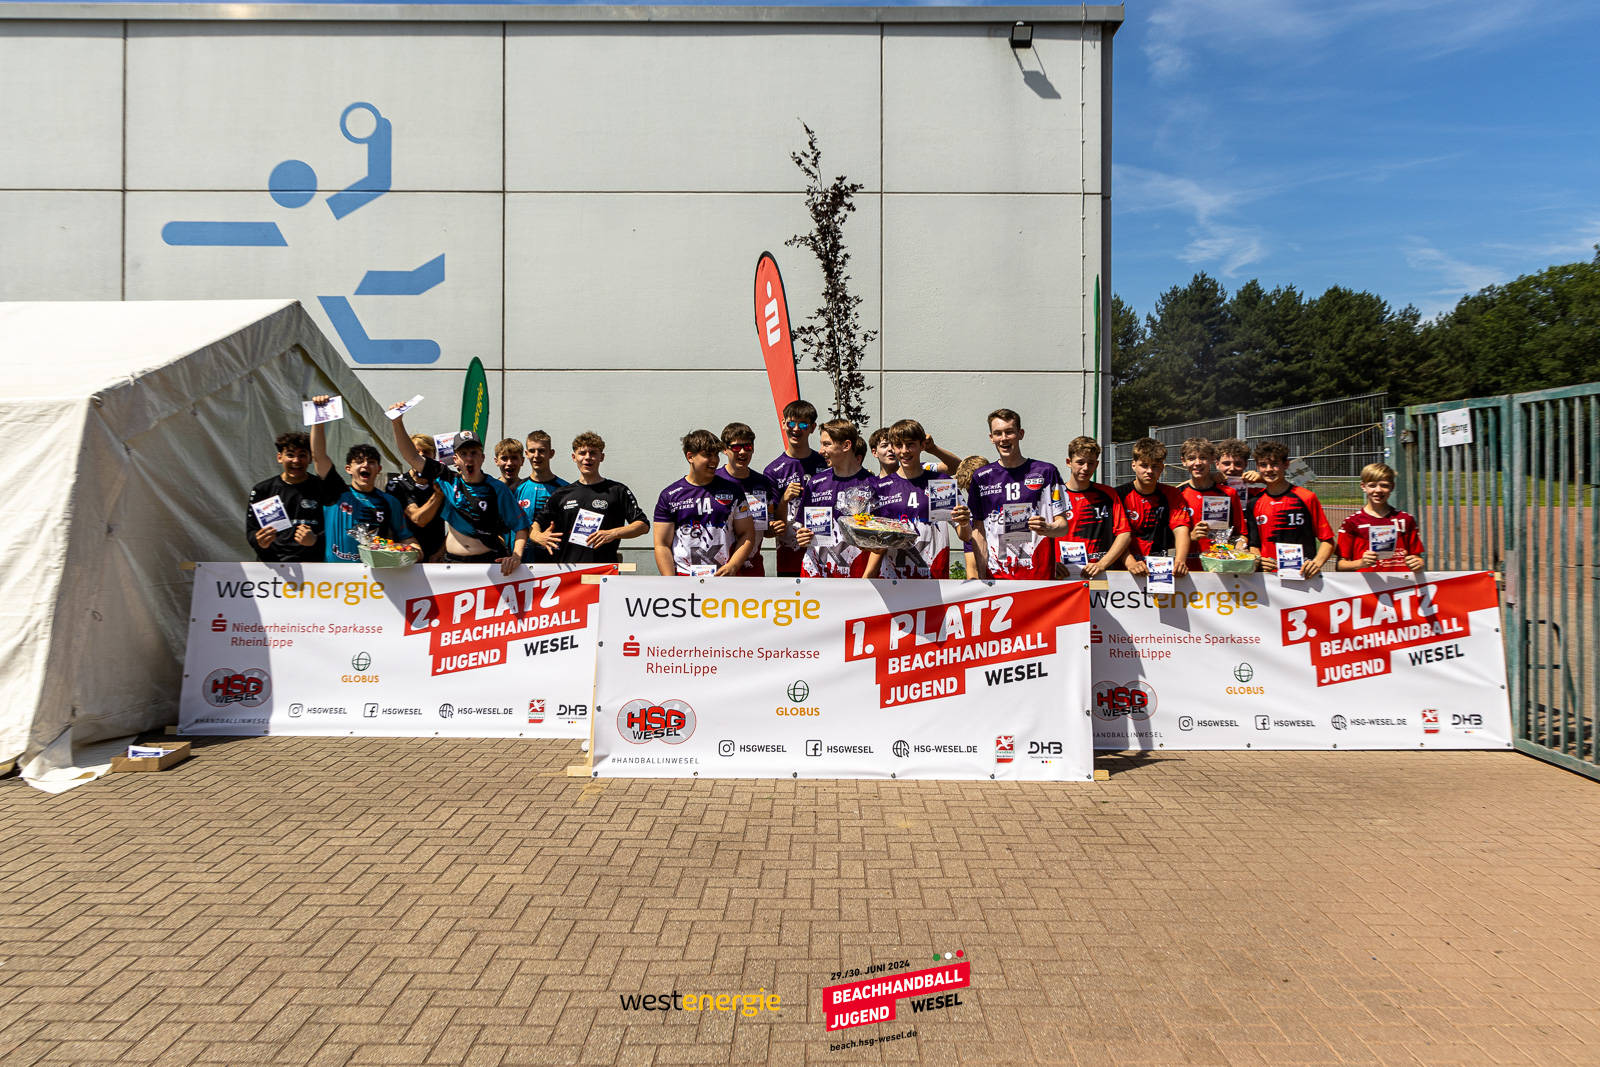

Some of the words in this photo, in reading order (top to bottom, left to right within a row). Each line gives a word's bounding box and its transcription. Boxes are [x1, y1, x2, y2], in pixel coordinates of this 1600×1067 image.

[1004, 482, 1021, 501] 13
[695, 497, 714, 515] 14
[907, 491, 920, 508] 4
[376, 511, 385, 522] 5
[1094, 506, 1109, 519] 14
[1288, 513, 1305, 526] 15
[1390, 518, 1406, 532] 11
[216, 575, 385, 605] westenergie
[410, 598, 441, 632] 2.
[452, 576, 562, 625] PLATZ
[1090, 584, 1258, 616] westenergie
[625, 590, 821, 627] westenergie
[1287, 608, 1318, 642] 3.
[1329, 584, 1439, 634] PLATZ
[231, 623, 326, 634] Niederrheinische
[328, 623, 383, 635] Sparkasse
[440, 609, 581, 647] BEACHHANDBALL
[852, 620, 875, 657] 1.
[889, 595, 1014, 650] PLATZ
[230, 636, 293, 648] RheinLippe
[1108, 633, 1202, 645] Niederrheinische
[1204, 633, 1261, 646] Sparkasse
[1320, 617, 1463, 657] BEACHHANDBALL
[435, 648, 501, 674] JUGEND
[524, 634, 579, 657] WESEL
[646, 646, 754, 659] Niederrheinische
[757, 647, 820, 661] Sparkasse
[888, 632, 1049, 675] BEACHHANDBALL
[1109, 648, 1172, 660] RheinLippe
[646, 662, 718, 676] RheinLippe
[1320, 658, 1386, 684] JUGEND
[1408, 643, 1465, 666] WESEL
[211, 673, 263, 697] HSG
[341, 675, 380, 683] GLOBUS
[885, 676, 958, 705] JUGEND
[984, 661, 1049, 687] WESEL
[1225, 686, 1265, 695] GLOBUS
[214, 692, 258, 704] WESEL
[1096, 686, 1149, 710] HSG
[306, 706, 348, 715] HSGWESEL
[382, 707, 423, 716] HSGWESEL
[457, 707, 514, 716] HSG-WESEL.DE
[556, 704, 588, 716] DHB
[776, 707, 820, 716] GLOBUS
[1102, 705, 1145, 717] WESEL
[194, 717, 271, 725] #HANDBALLINWESEL
[627, 705, 686, 732] HSG
[1197, 719, 1239, 727] HSGWESEL
[1274, 719, 1316, 727] HSGWESEL
[1350, 718, 1408, 726] HSG-WESEL.DE
[1451, 713, 1483, 725] DHB
[632, 727, 681, 740] WESEL
[740, 744, 787, 753] HSGWESEL
[827, 745, 874, 754] HSGWESEL
[914, 745, 978, 754] HSG-WESEL.DE
[1027, 741, 1063, 754] DHB
